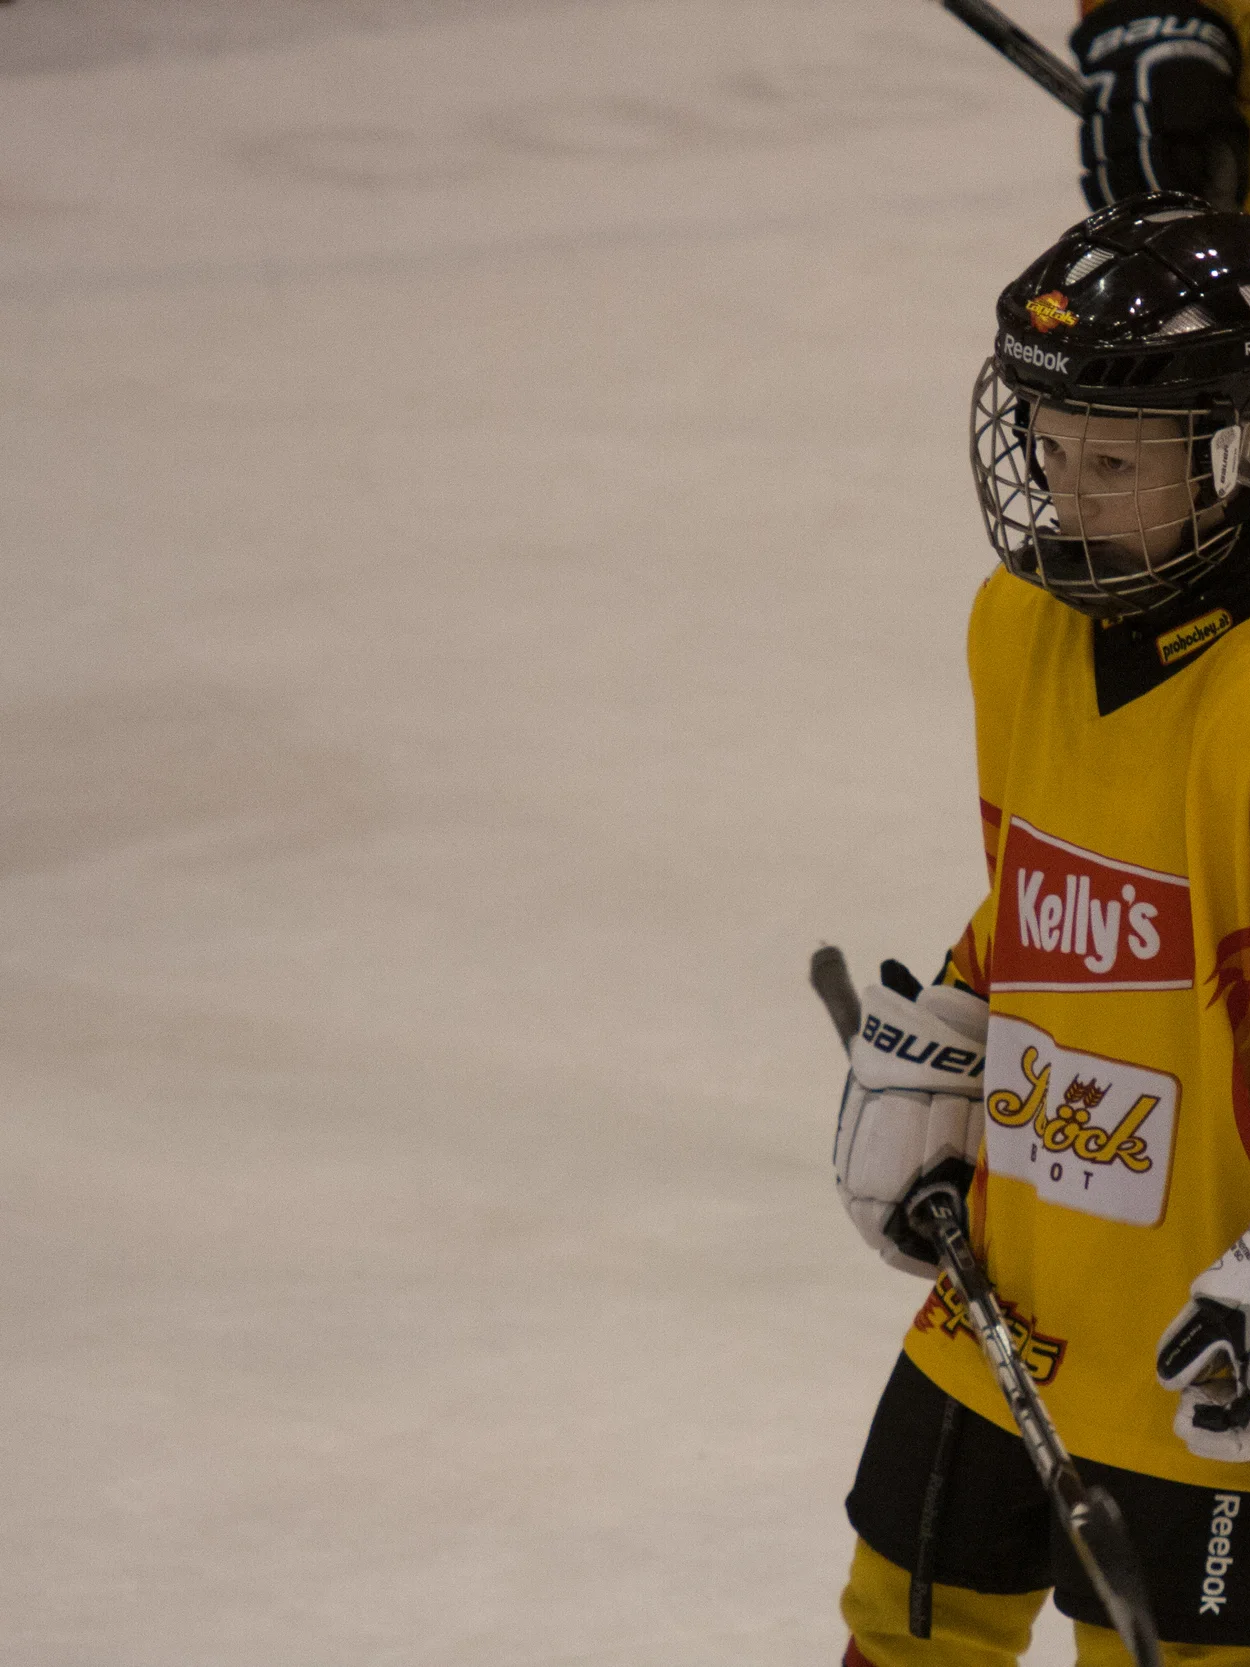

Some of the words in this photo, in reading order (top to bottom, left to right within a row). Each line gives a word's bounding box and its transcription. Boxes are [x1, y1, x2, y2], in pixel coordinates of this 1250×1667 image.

[1003, 332, 1069, 374] Reebok
[1017, 867, 1161, 974] Kelly's
[1199, 1494, 1241, 1616] Reebok
